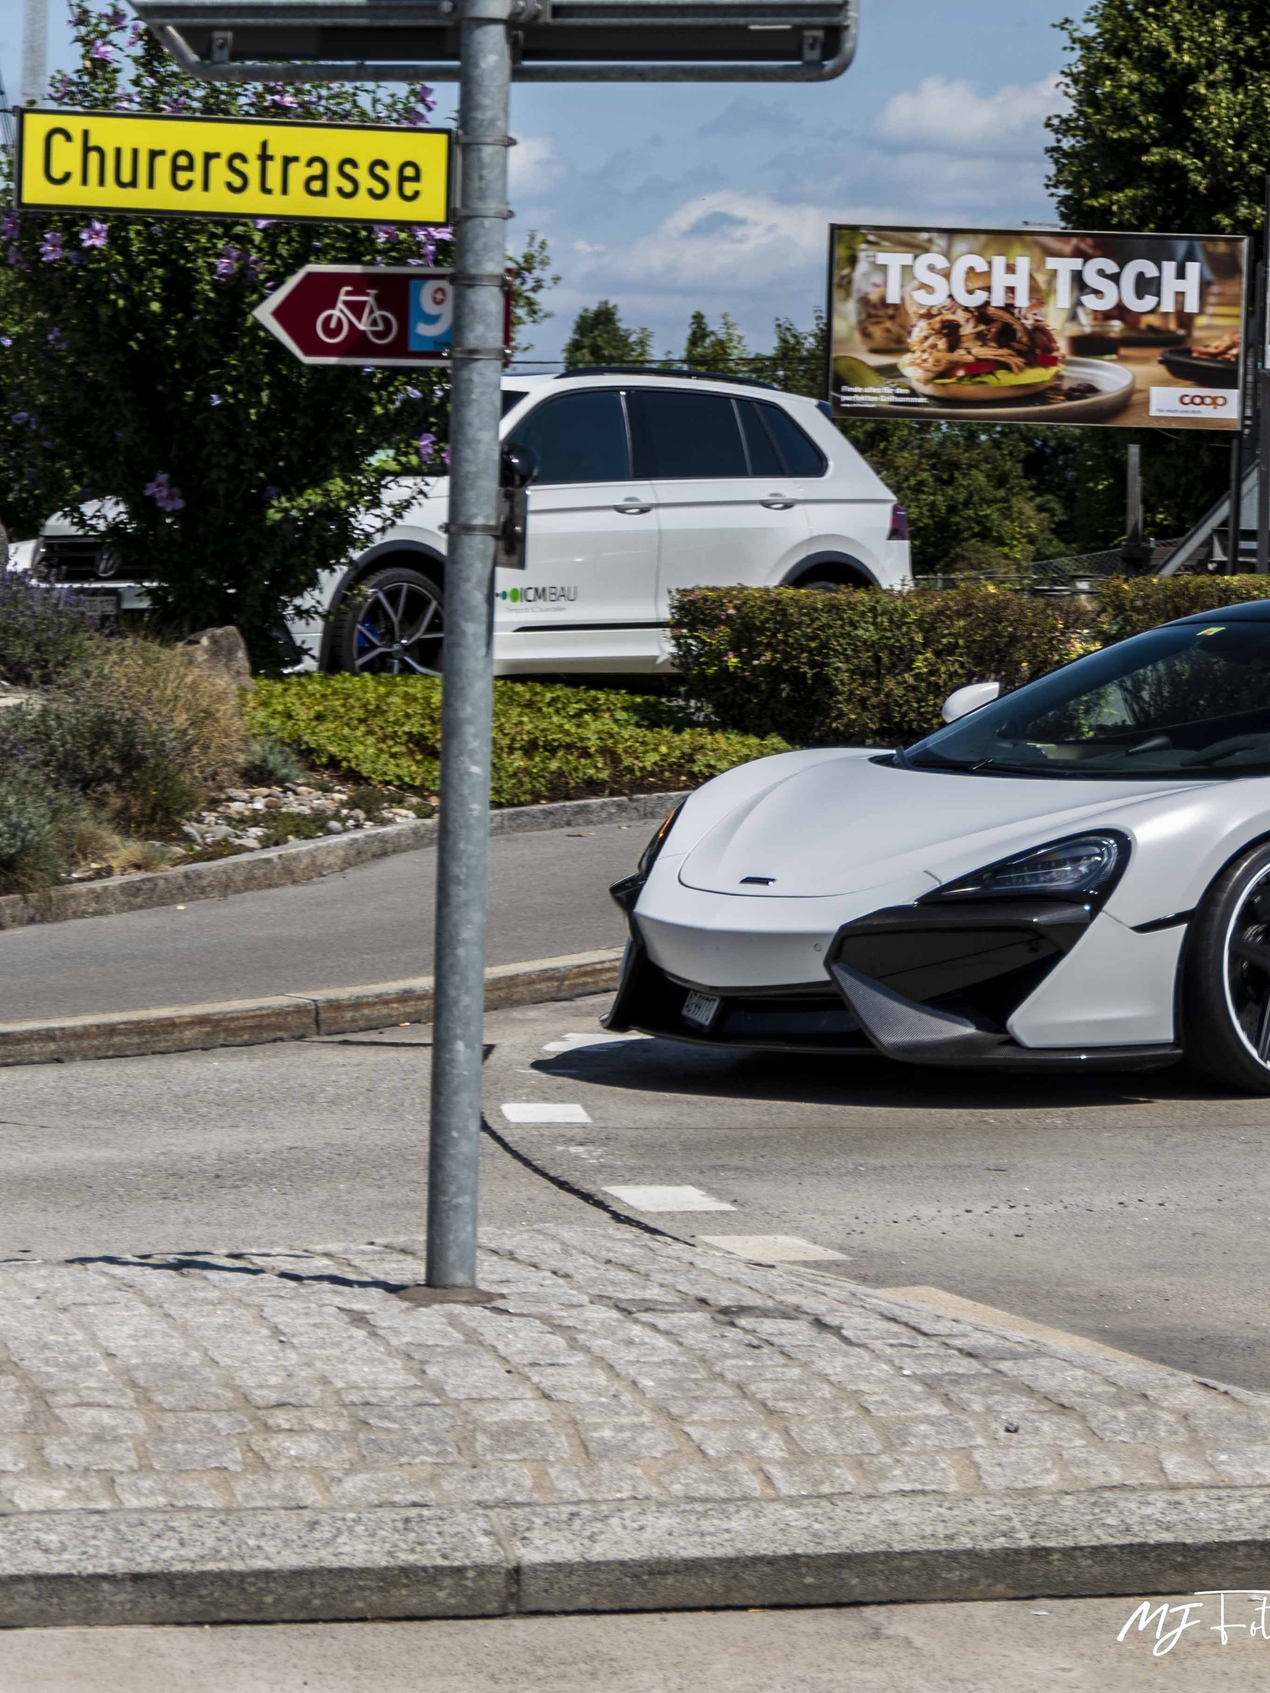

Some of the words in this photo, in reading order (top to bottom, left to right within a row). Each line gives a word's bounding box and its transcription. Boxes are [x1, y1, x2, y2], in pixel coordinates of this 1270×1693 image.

[43, 126, 423, 203] Churerstrasse
[415, 279, 454, 337] 9
[875, 251, 1031, 308] TSCH
[1045, 256, 1201, 314] TSCH
[1179, 394, 1228, 410] coop
